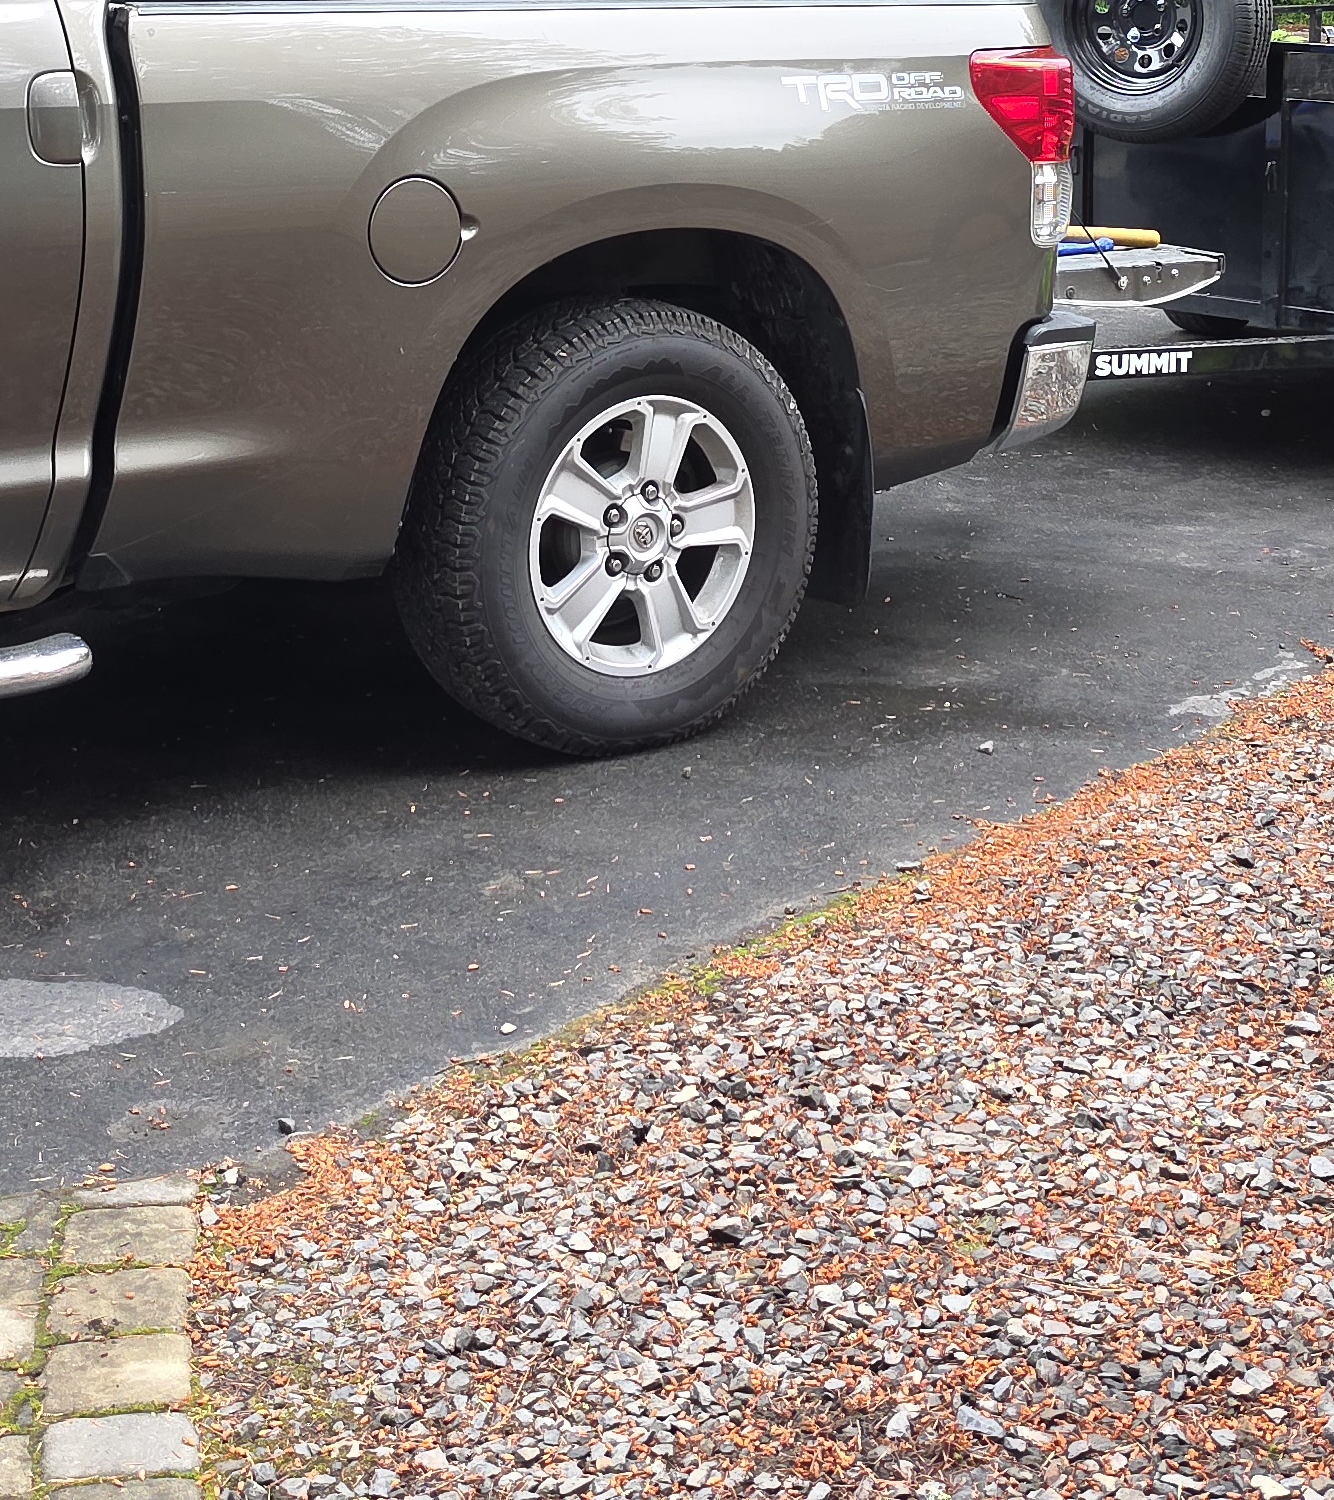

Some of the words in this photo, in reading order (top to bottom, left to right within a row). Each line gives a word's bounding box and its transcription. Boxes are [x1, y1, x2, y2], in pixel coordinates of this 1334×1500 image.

[891, 71, 943, 86] OFF
[780, 73, 891, 112] TRD
[892, 86, 965, 102] ROAD
[1094, 350, 1193, 377] SUMMIT
